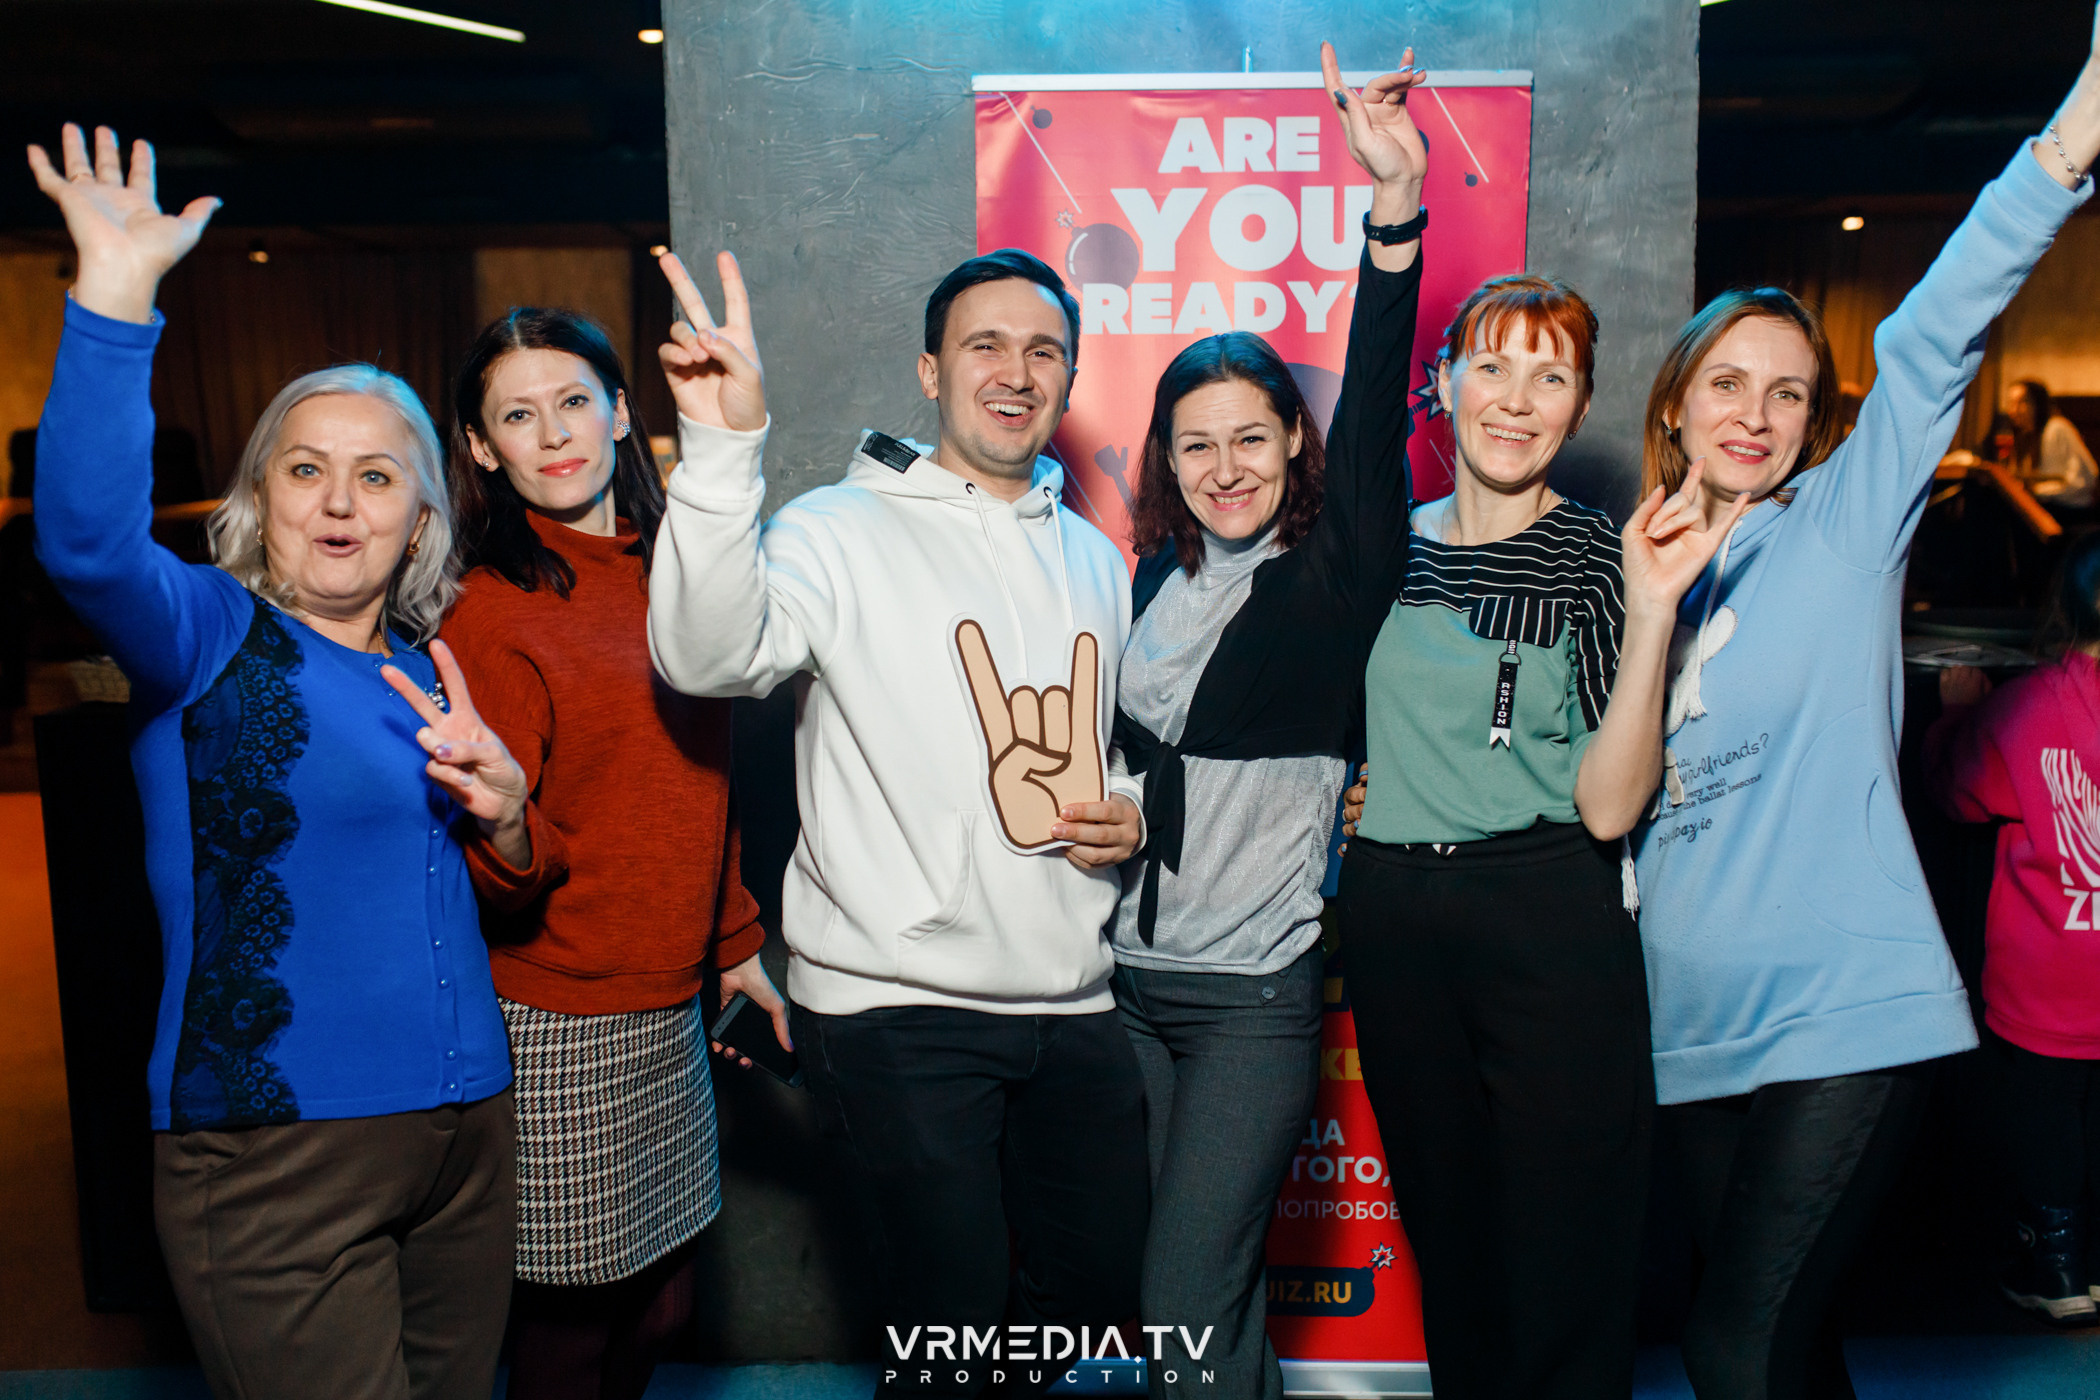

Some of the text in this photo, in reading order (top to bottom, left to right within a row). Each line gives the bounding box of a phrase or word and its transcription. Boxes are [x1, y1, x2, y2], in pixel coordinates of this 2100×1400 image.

[1157, 115, 1321, 174] ARE
[1110, 184, 1375, 272] YOU
[1082, 280, 1358, 335] READY
